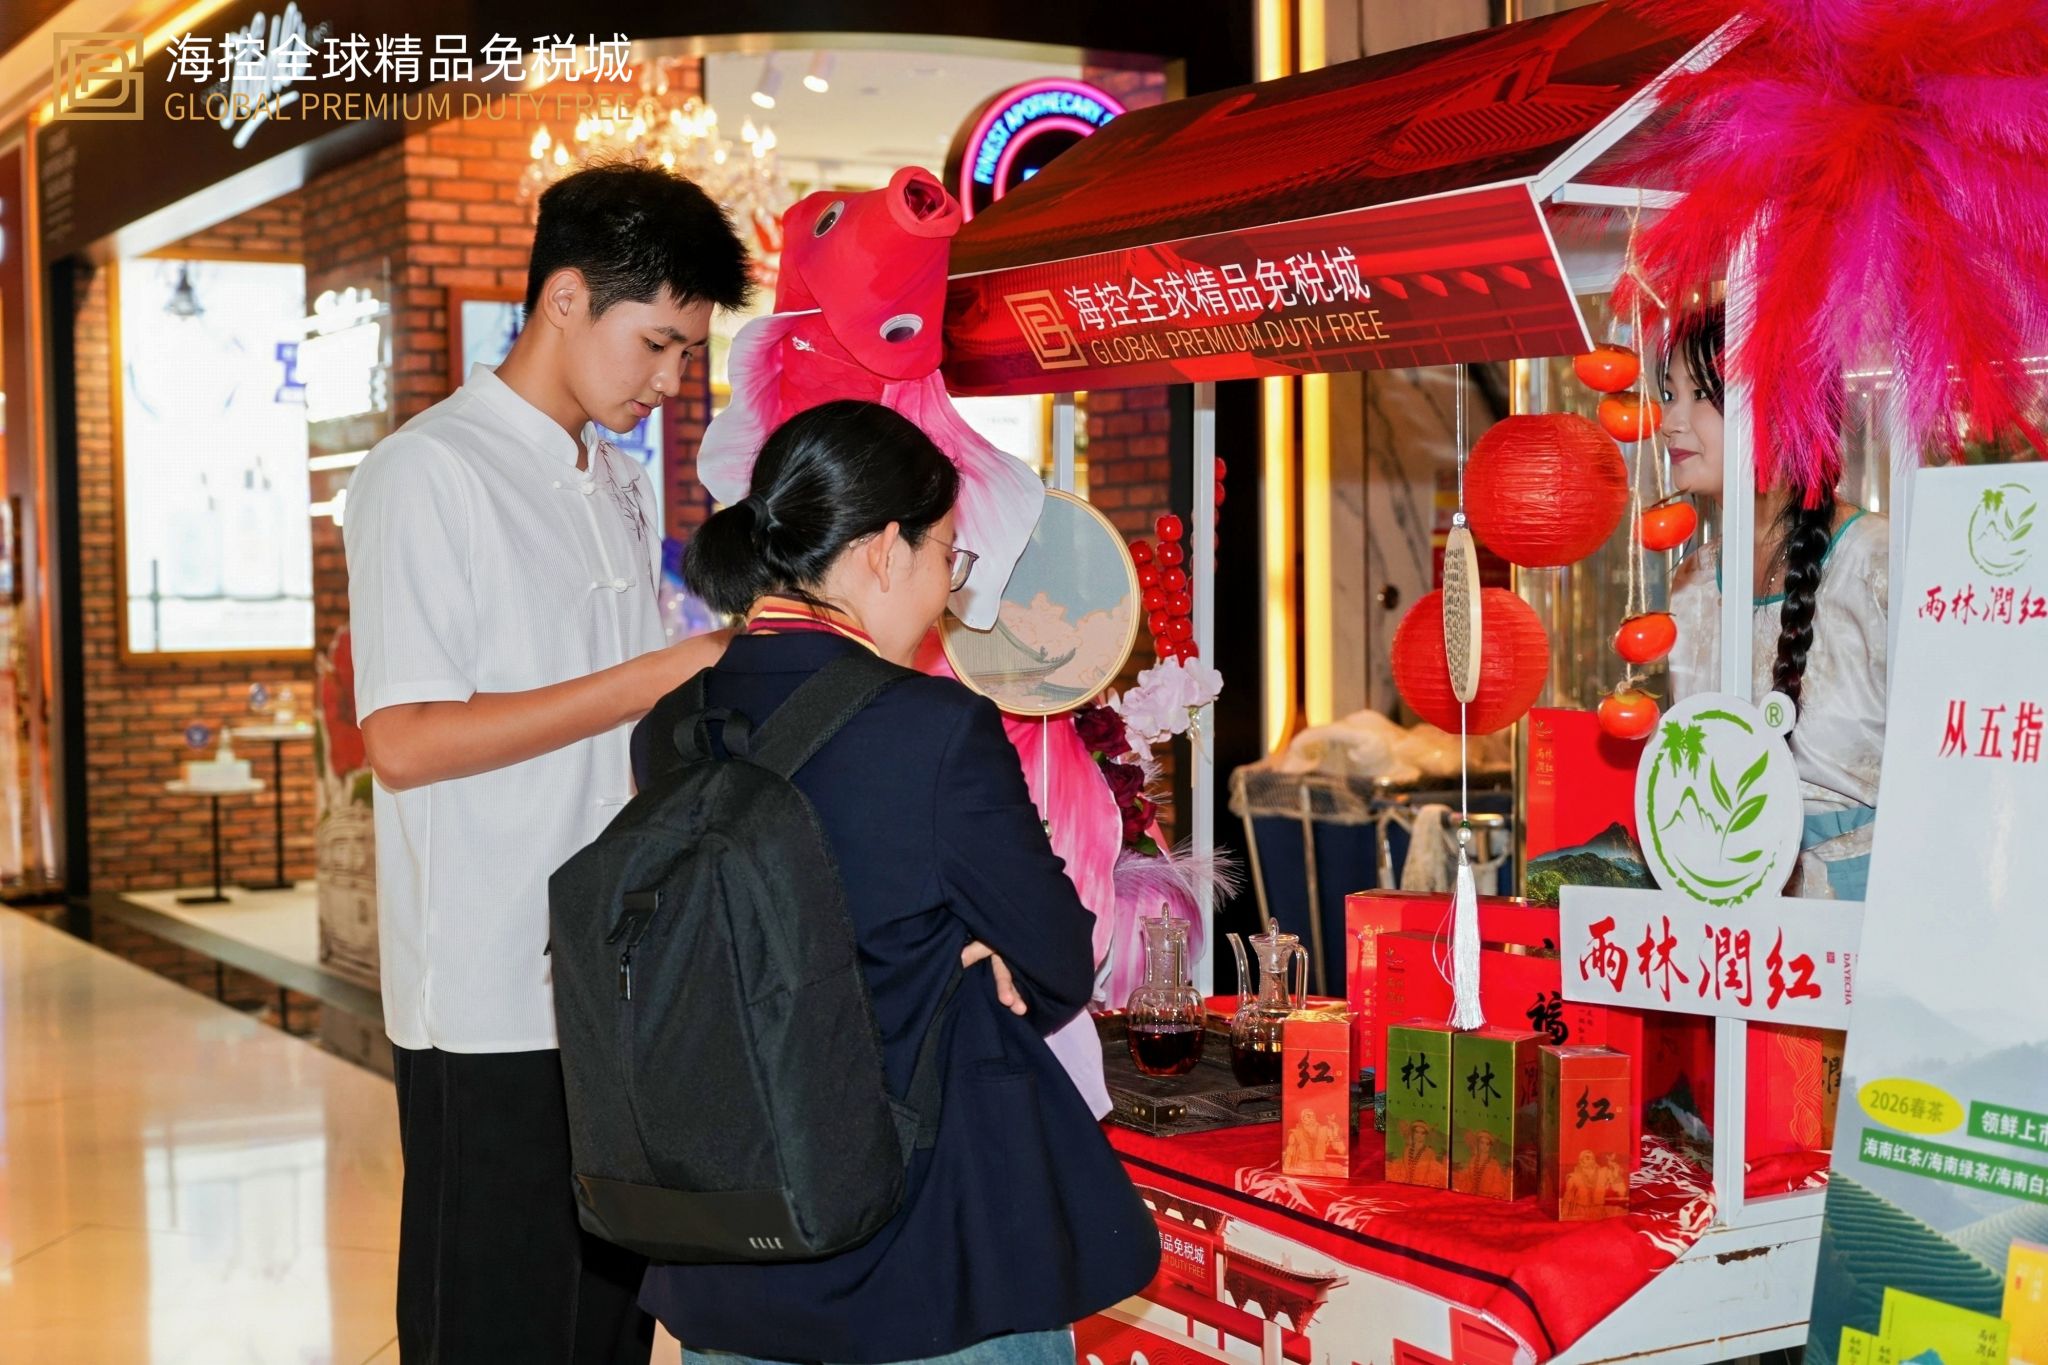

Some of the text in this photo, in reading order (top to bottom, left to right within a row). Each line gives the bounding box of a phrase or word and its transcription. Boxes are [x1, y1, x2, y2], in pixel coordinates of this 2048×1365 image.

[1063, 245, 1371, 332] 海控全球精品免税城
[1090, 309, 1391, 365] GLOBAL PREMIUM DUTY FREE
[1938, 700, 2044, 763] 从五指
[1526, 990, 1568, 1046] 福
[1297, 1049, 1335, 1089] 红
[1401, 1053, 1437, 1098] 林
[1466, 1062, 1502, 1108] 林
[1576, 1085, 1615, 1129] 红
[1869, 1089, 1944, 1123] 2026春茶
[748, 1236, 784, 1249] ELLE
